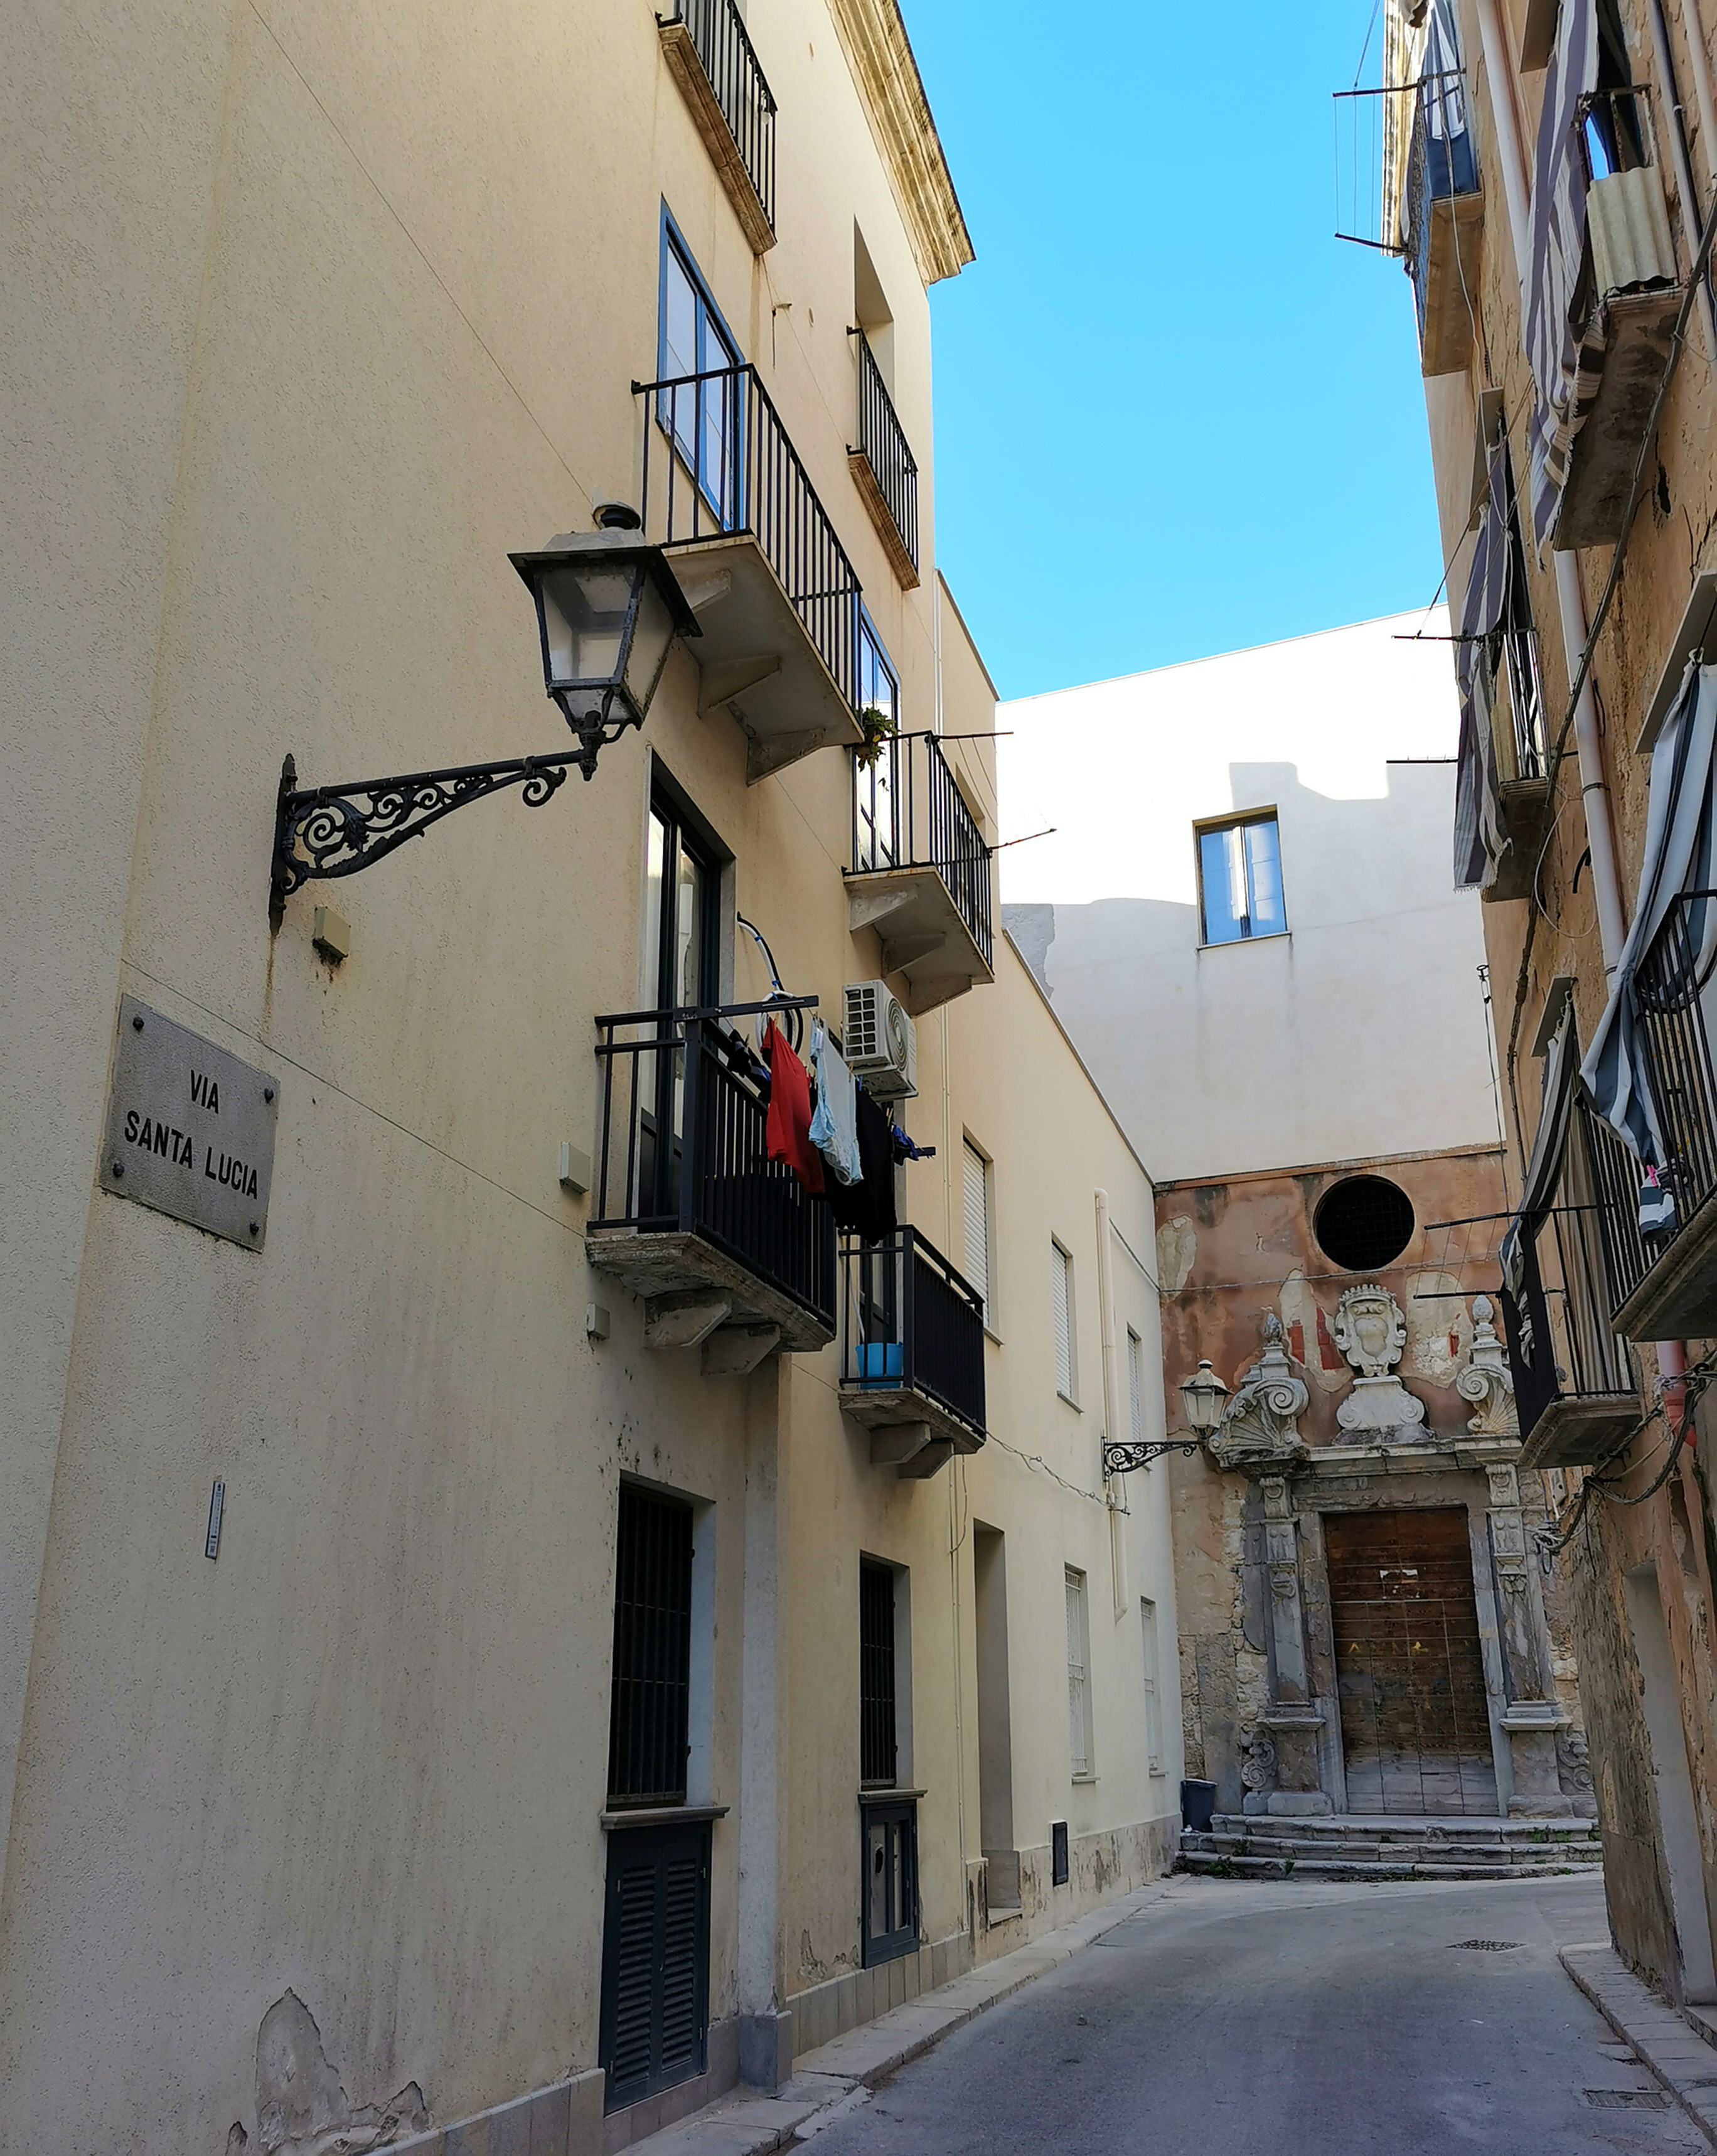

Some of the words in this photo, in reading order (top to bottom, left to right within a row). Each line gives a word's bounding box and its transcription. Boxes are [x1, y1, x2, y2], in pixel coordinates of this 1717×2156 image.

[191, 1069, 219, 1113] VIA
[125, 1110, 193, 1169] SANTA
[205, 1147, 258, 1199] LUCIA
